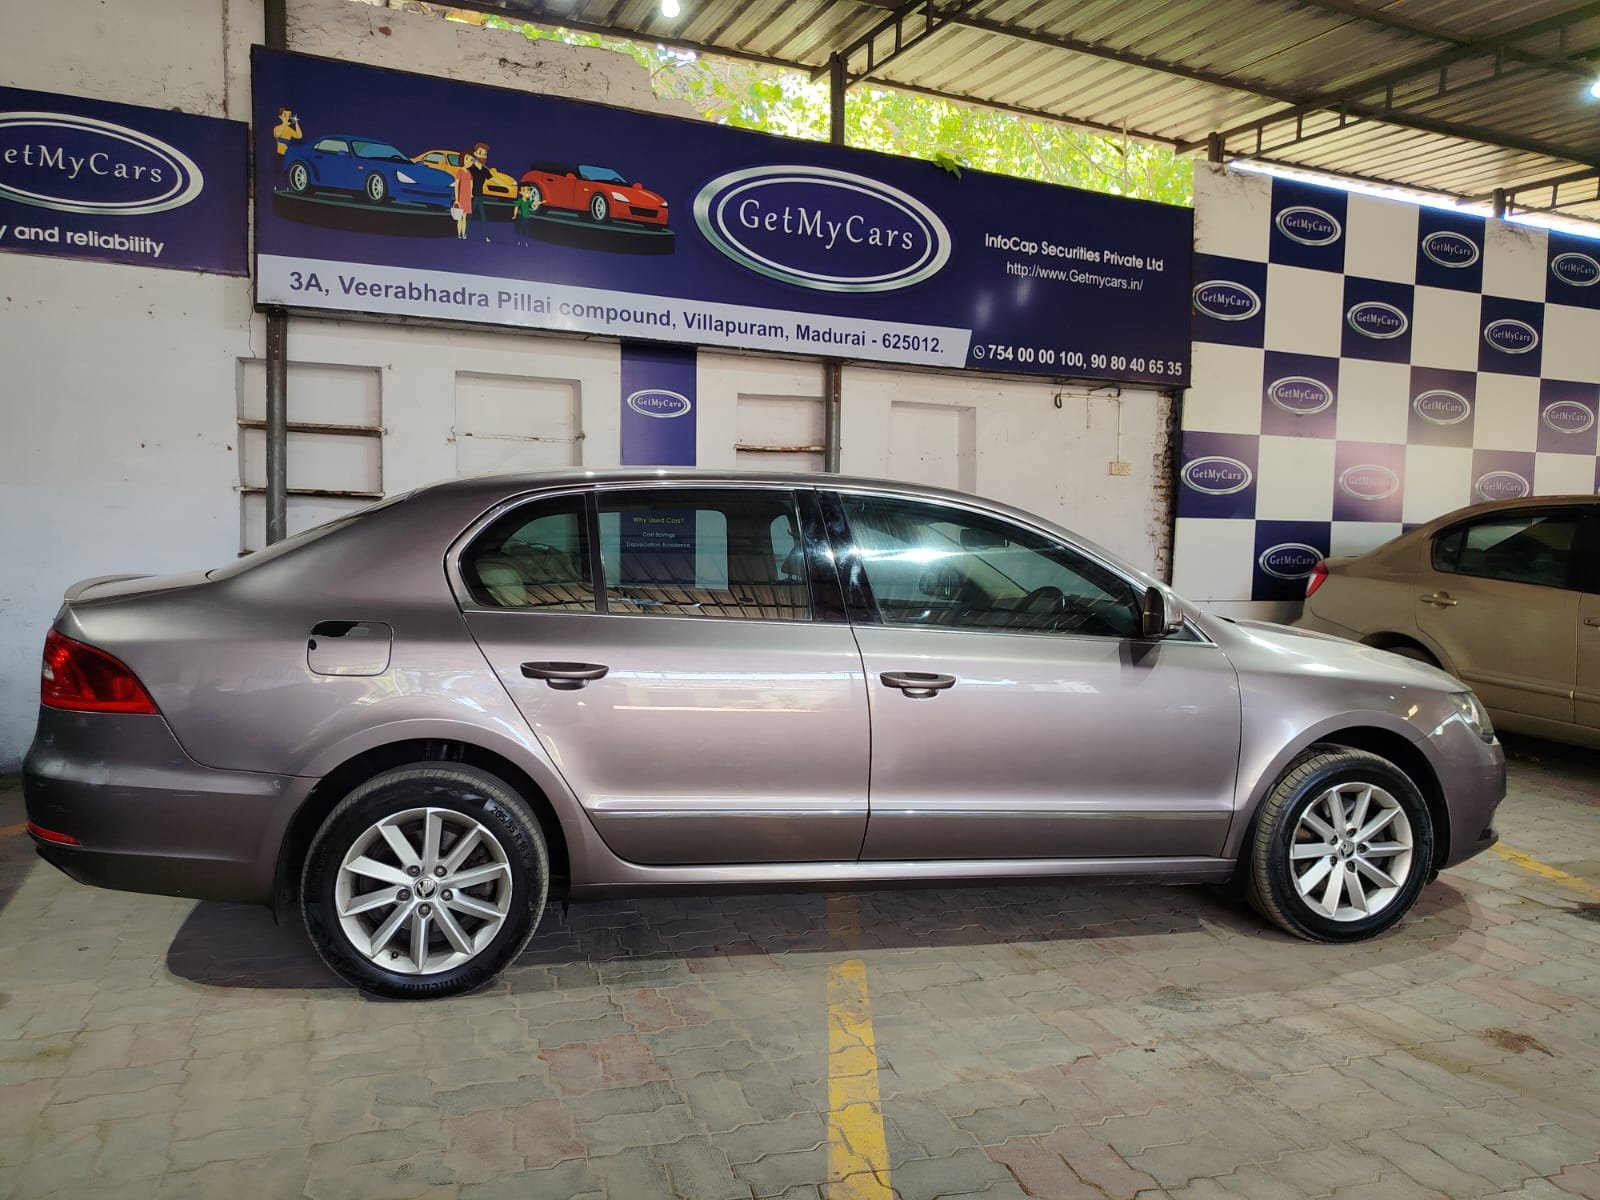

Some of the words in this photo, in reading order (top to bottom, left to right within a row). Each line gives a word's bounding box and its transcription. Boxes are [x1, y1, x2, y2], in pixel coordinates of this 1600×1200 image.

[3, 143, 163, 184] etMyCars
[738, 198, 914, 251] GetMyCars
[1285, 215, 1332, 234] GetMyCars
[14, 225, 60, 243] and
[65, 230, 165, 258] reliability
[1430, 240, 1472, 257] GetMyCars
[984, 232, 1039, 256] InfoCap
[1040, 240, 1101, 263] Securities
[1103, 250, 1144, 270] Private
[1146, 256, 1164, 272] Ltd
[1005, 260, 1144, 292] http://www.Getmycars.in/
[1558, 261, 1596, 277] GetMyCars
[1200, 290, 1251, 309] GetMyCars
[288, 271, 331, 297] 3A,
[337, 274, 490, 308] Veerabhadra
[496, 289, 552, 315] Pillai
[558, 301, 677, 331] compound,
[682, 310, 790, 342] Villapuram,
[795, 323, 866, 347] Madurai
[881, 332, 945, 354] 625012.
[1355, 310, 1400, 328] GetMyCars
[1491, 327, 1531, 344] GetMyCars
[987, 344, 1014, 361] 754
[1017, 347, 1035, 363] 00
[1038, 349, 1055, 365] 00
[1059, 350, 1088, 370] 100,
[1090, 353, 1107, 369] 90
[1110, 355, 1127, 371] 80
[1129, 357, 1145, 373] 40
[1148, 359, 1165, 374] 65
[1167, 361, 1183, 377] 35
[1277, 386, 1325, 402] GetMyCars
[637, 397, 682, 409] GetMyCars
[1421, 399, 1463, 414] GetMyCars
[1550, 410, 1588, 425] GetMyCars
[1191, 467, 1243, 482] GetMyCars
[1348, 474, 1391, 489] GetMy
[1483, 480, 1522, 495] GetMyCars
[1268, 554, 1316, 568] GetMyCars
